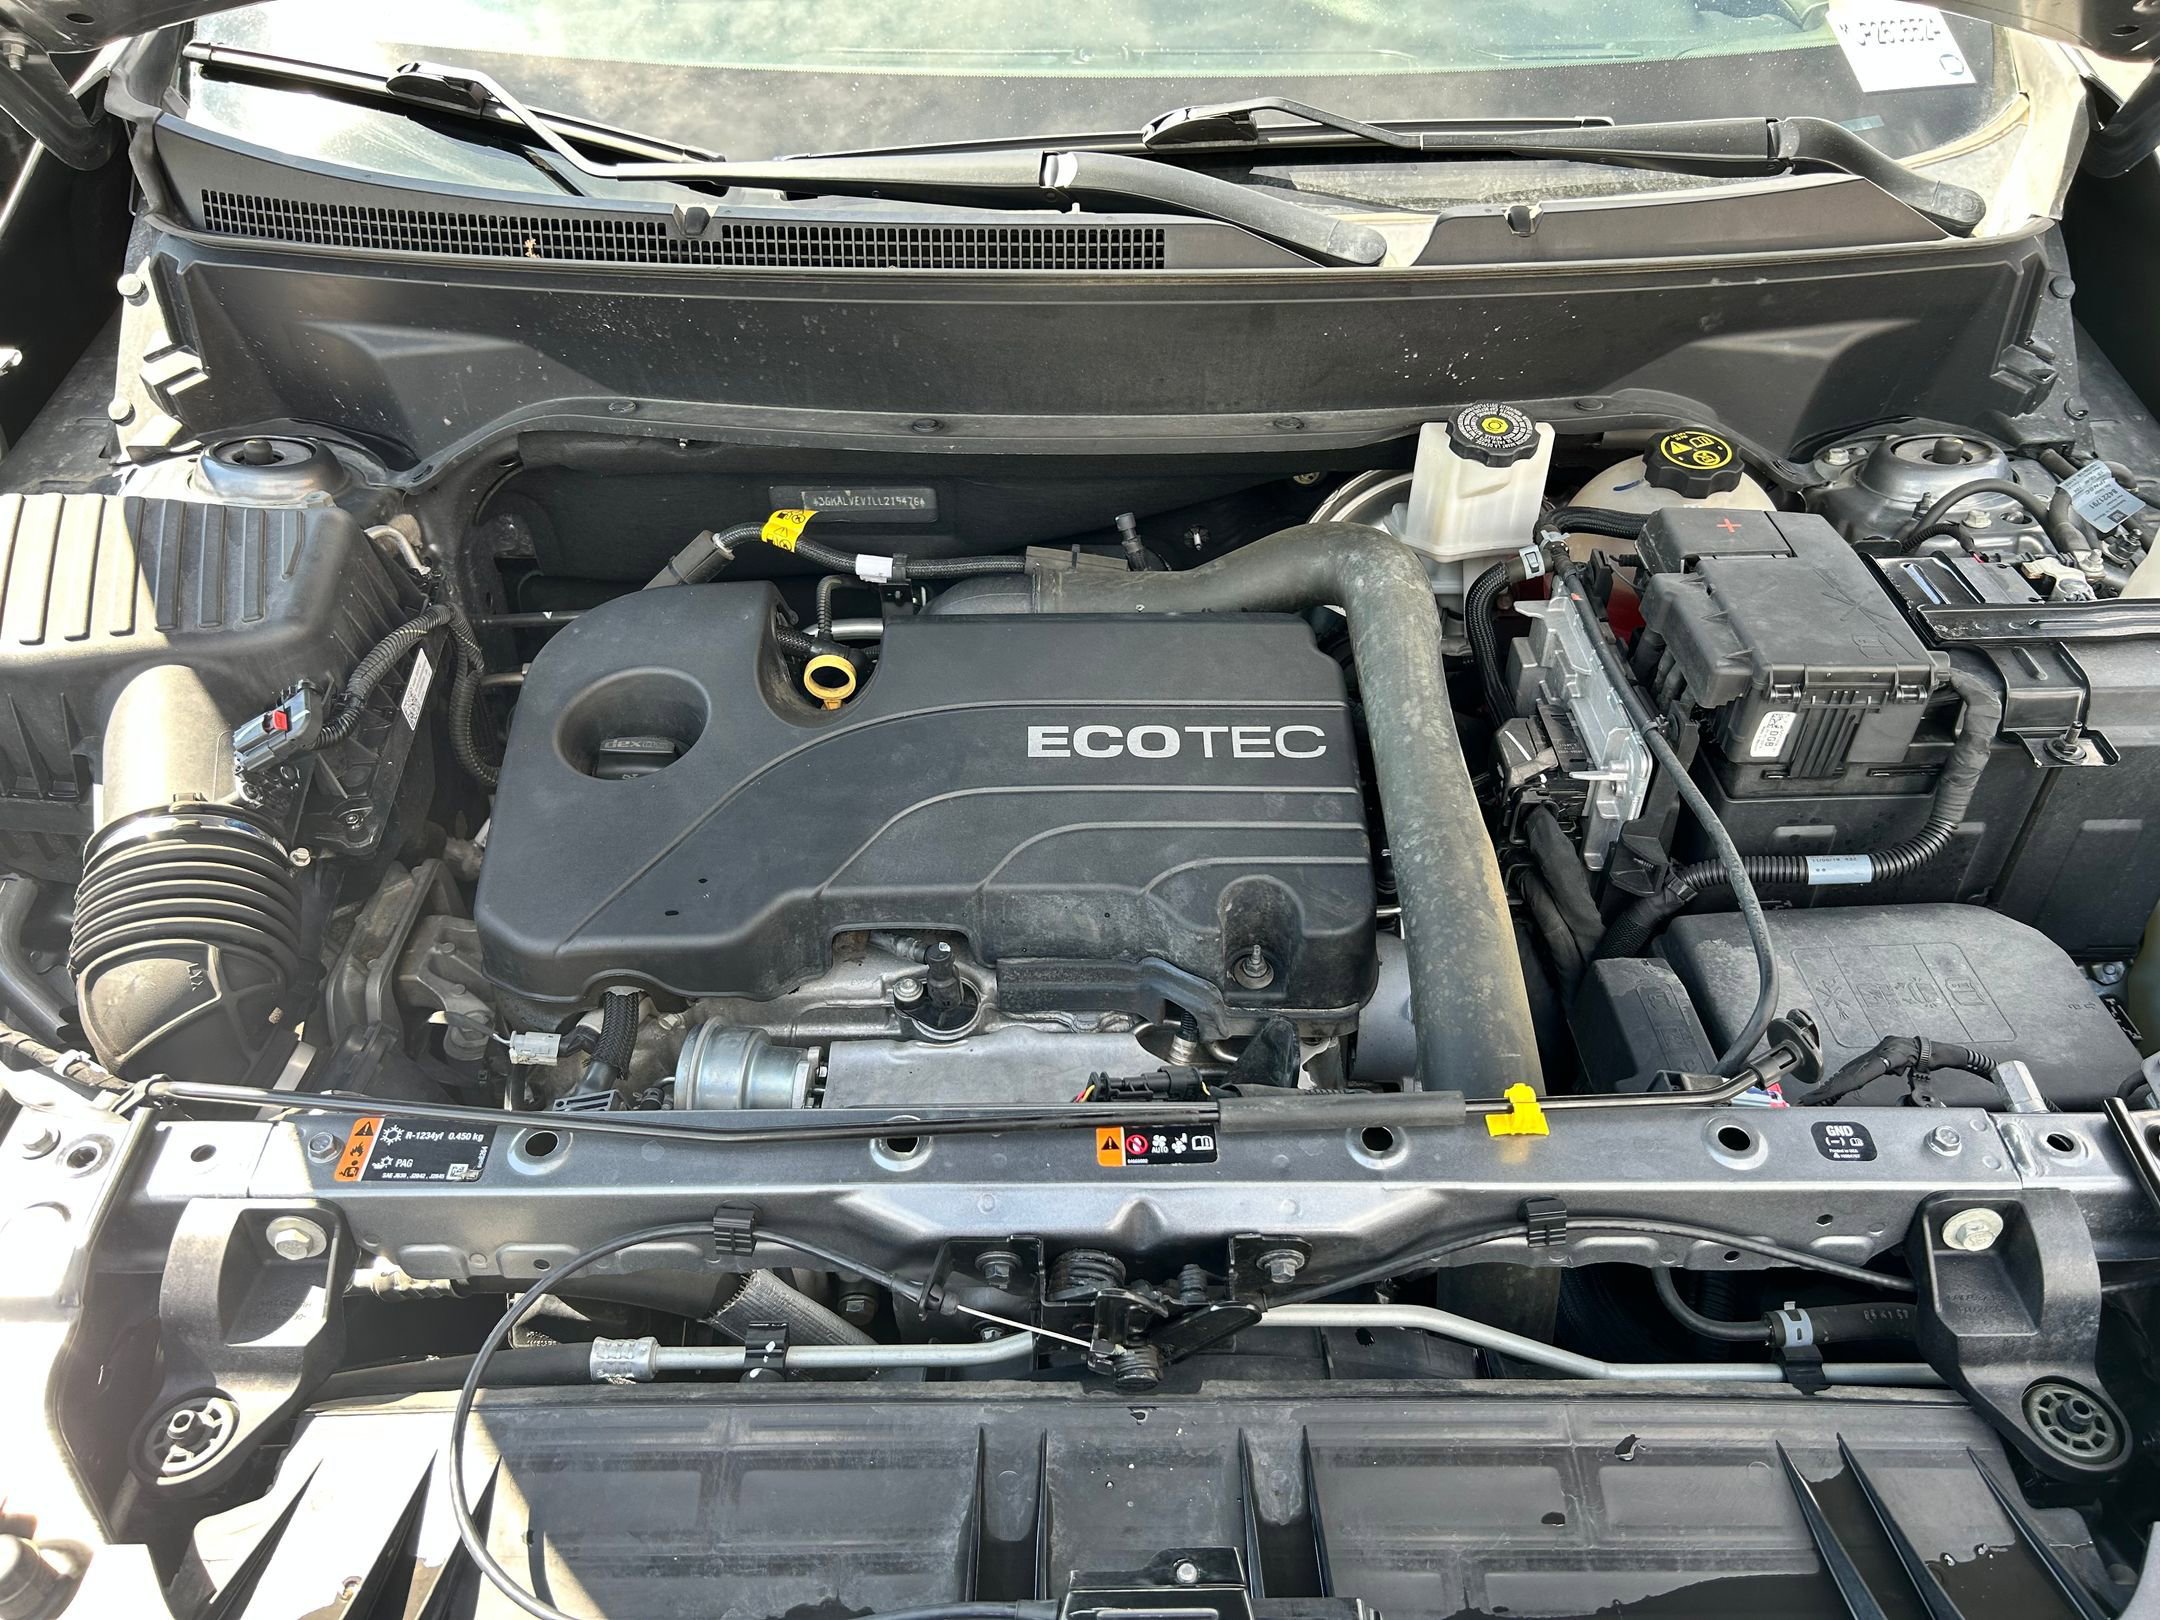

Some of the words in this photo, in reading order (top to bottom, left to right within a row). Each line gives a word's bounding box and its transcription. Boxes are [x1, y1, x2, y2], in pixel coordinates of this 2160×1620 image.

[1027, 724, 1327, 759] ECOTEC
[405, 1131, 444, 1142] R-1234yf
[448, 1132, 472, 1141] 0.450
[472, 1132, 485, 1142] kg
[1825, 1125, 1854, 1137] GND
[1151, 1146, 1169, 1154] AUTO
[395, 1158, 414, 1168] PAG
